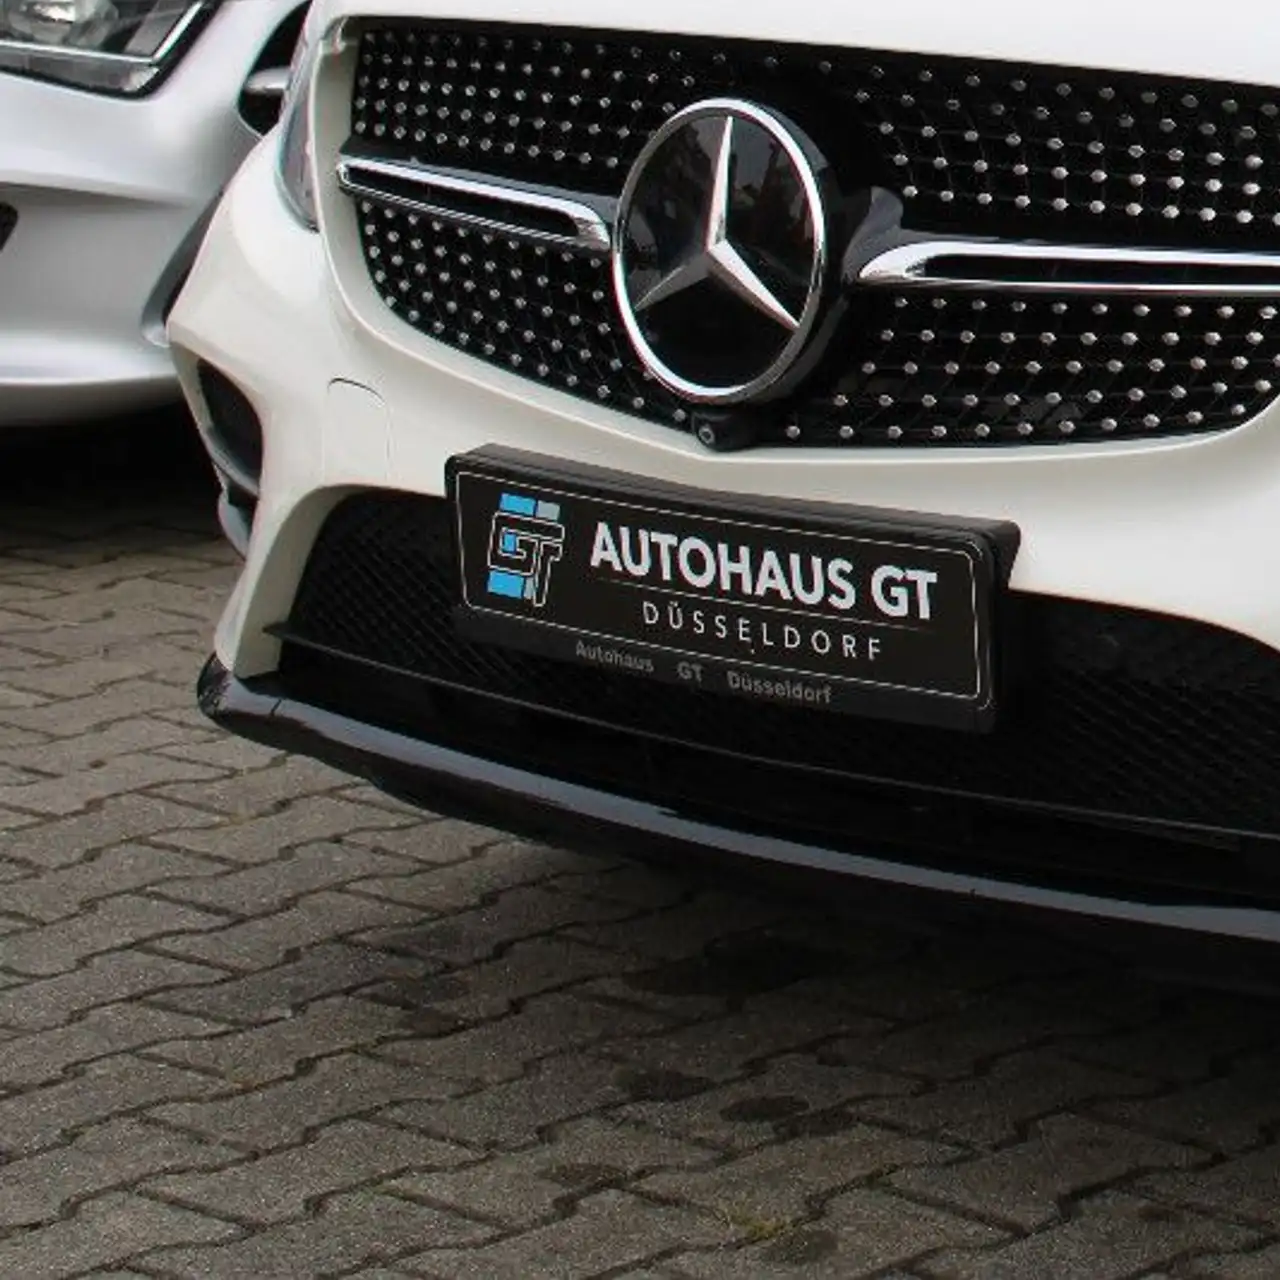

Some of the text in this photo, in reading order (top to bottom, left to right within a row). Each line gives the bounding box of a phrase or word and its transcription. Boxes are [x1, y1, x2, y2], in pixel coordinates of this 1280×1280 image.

[589, 521, 939, 621] AUTOHAUS GT
[642, 600, 884, 661] DÜSSELDORF
[575, 640, 833, 704] Autohaus GT Düsseldorf
